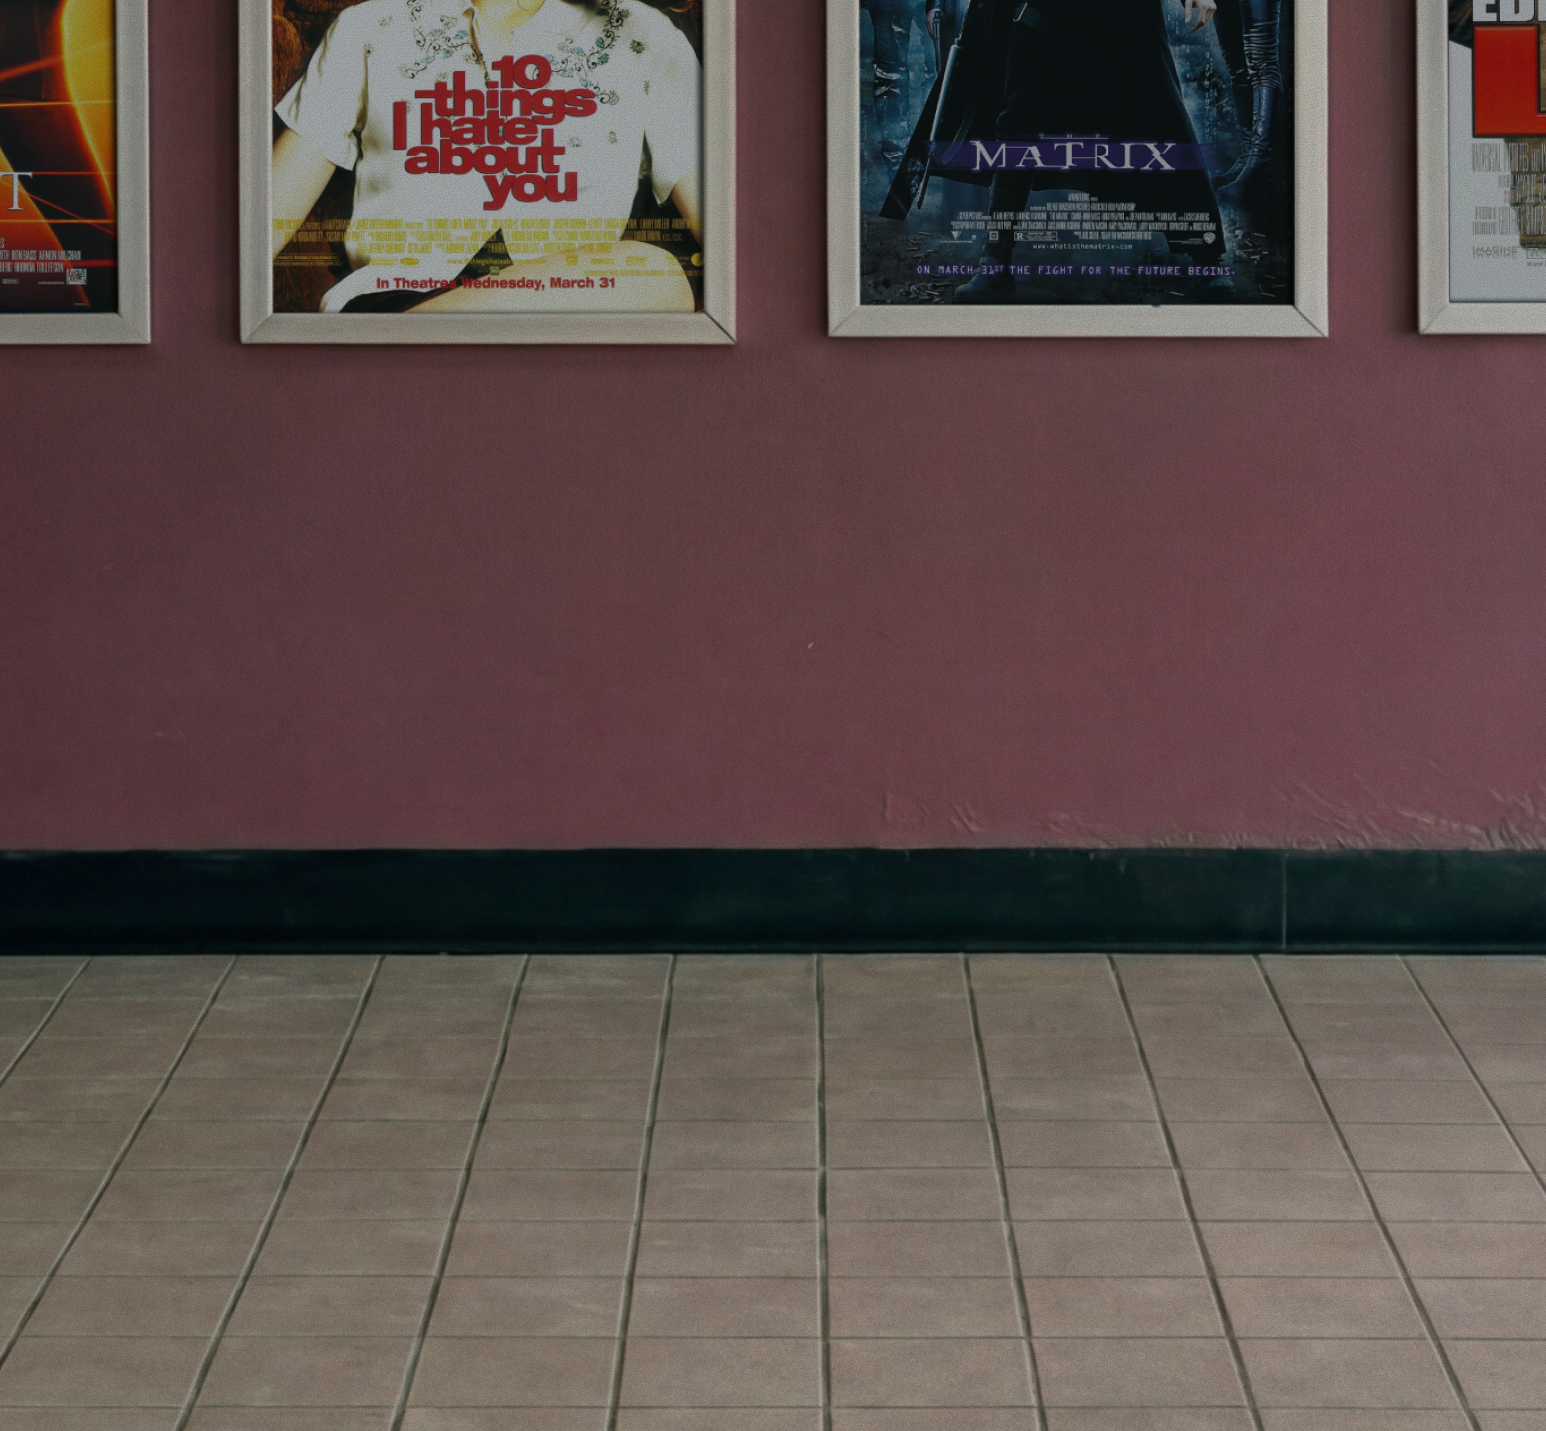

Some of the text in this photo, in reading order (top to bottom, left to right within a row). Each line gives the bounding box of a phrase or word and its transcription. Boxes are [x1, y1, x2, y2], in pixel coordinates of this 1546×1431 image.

[491, 54, 552, 89] 10
[415, 71, 597, 125] things
[392, 101, 538, 151] I hate
[404, 127, 566, 174] about
[970, 140, 1177, 171] MATRIX
[482, 171, 578, 211] you
[376, 276, 615, 291] In Theatres Wednesday, March 31
[917, 265, 930, 275] ON
[938, 265, 973, 275] MARCH
[1010, 265, 1030, 275] THE
[1039, 265, 1073, 275] FIGHT
[1081, 265, 1102, 275] FOR
[1110, 265, 1131, 275] THE
[1138, 265, 1180, 275] FUTURE
[1188, 265, 1236, 275] BEGINS.
